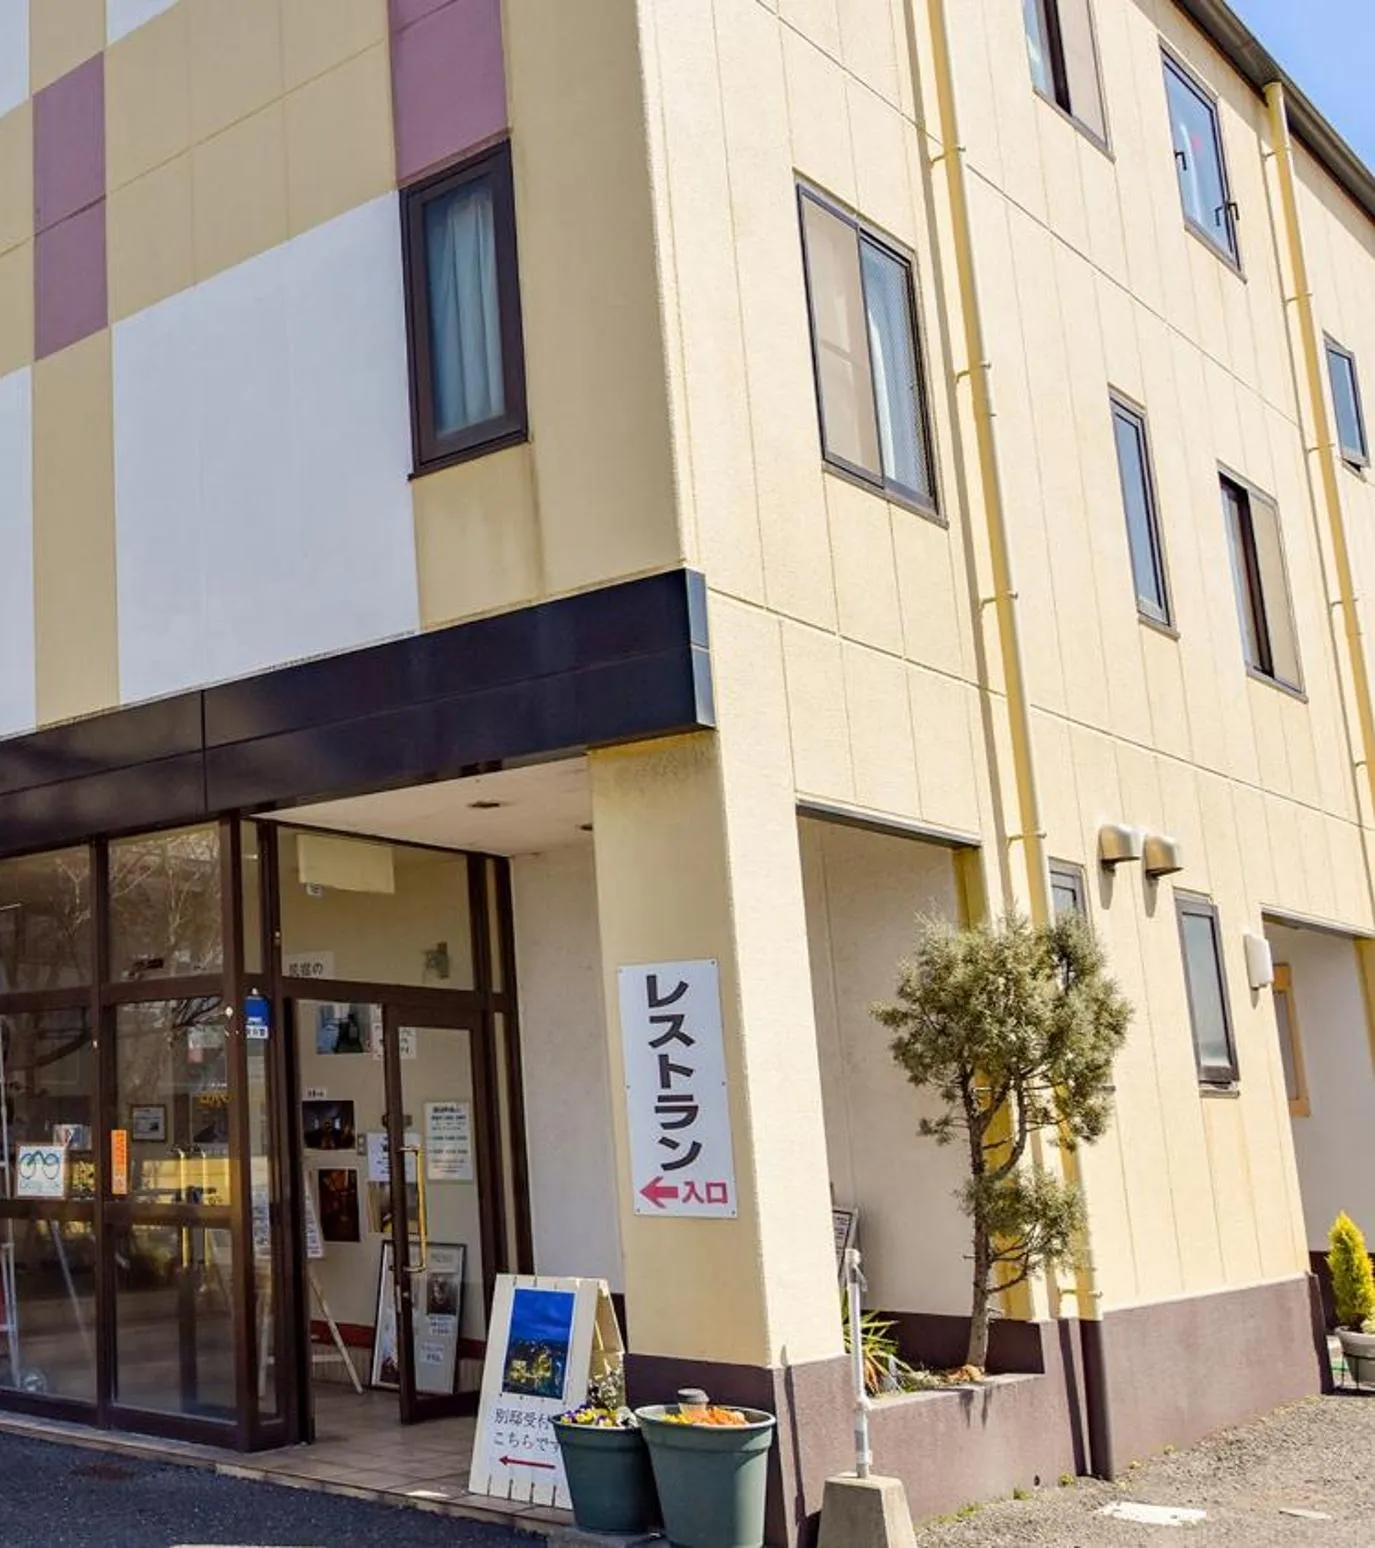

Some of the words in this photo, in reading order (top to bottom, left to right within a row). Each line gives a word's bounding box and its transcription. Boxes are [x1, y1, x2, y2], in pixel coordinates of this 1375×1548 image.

[646, 975, 702, 1171] レストラン
[682, 1181, 729, 1204] 入口
